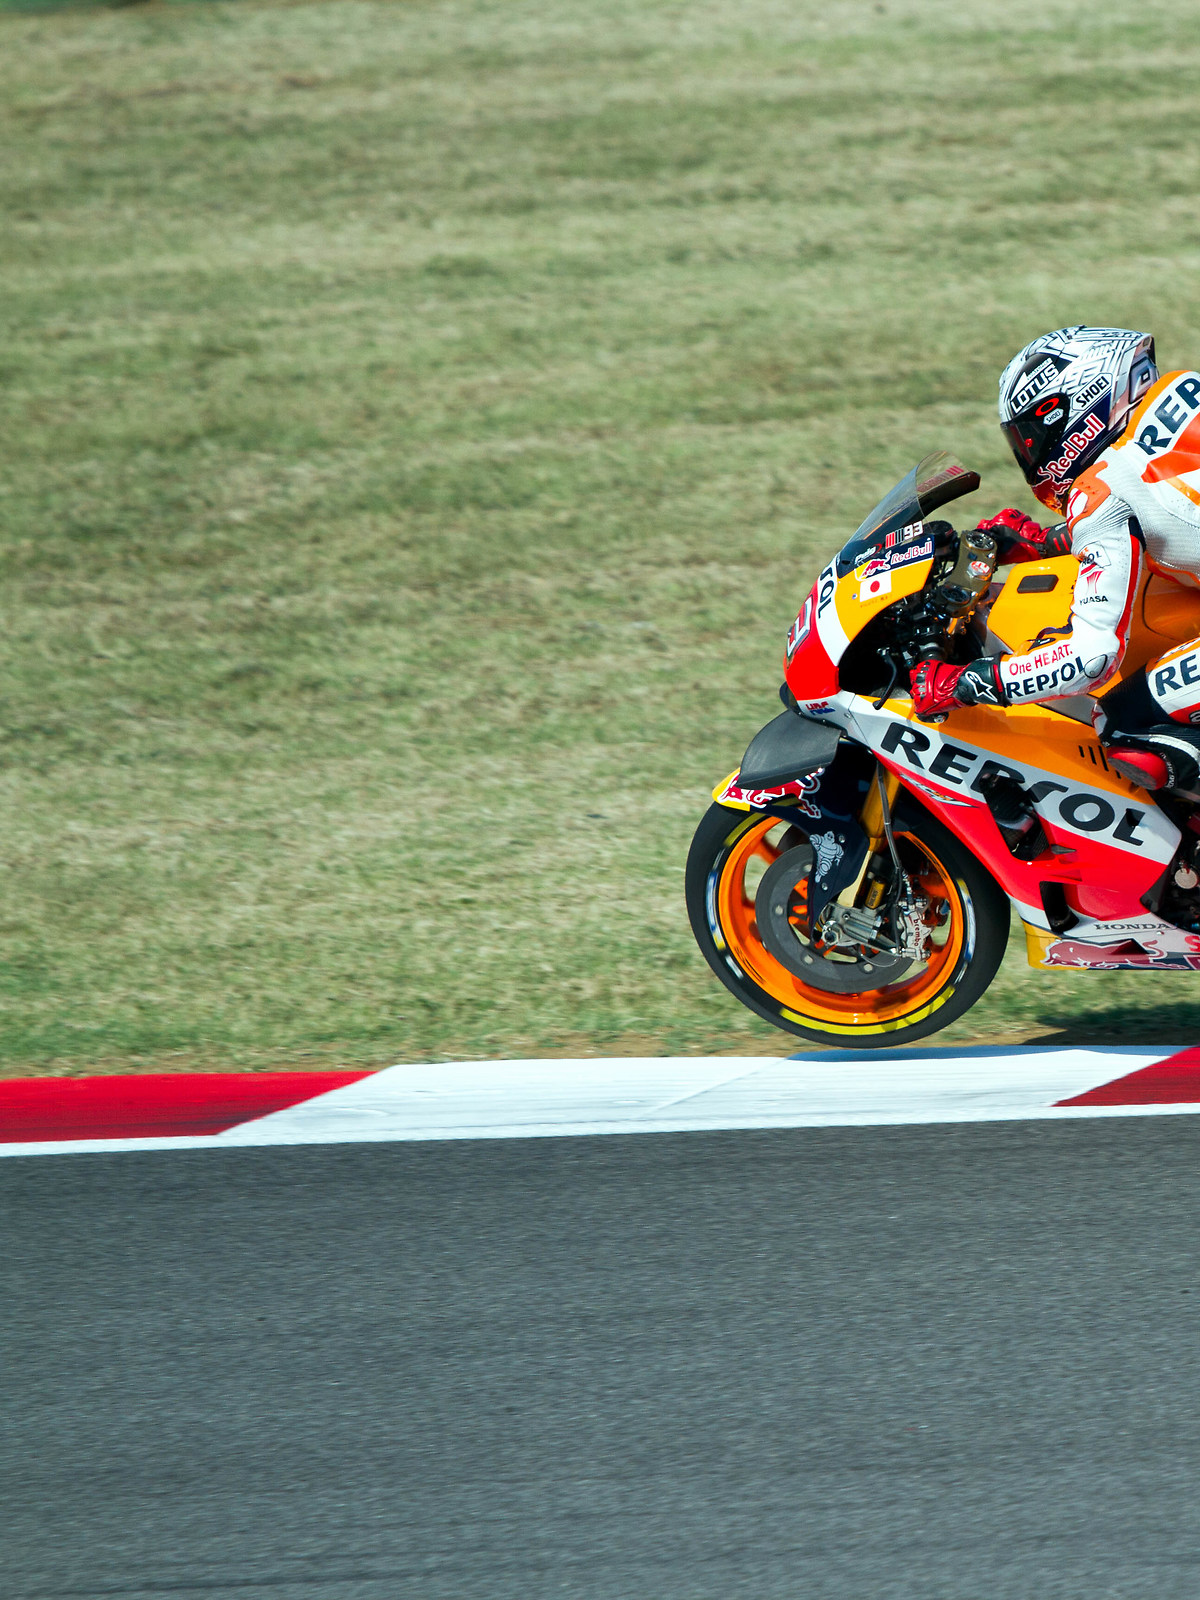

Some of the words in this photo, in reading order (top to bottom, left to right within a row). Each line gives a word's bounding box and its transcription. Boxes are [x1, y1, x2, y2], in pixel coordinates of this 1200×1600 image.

[1010, 364, 1060, 413] LOTUS
[1075, 375, 1110, 407] SHOEI
[1047, 441, 1080, 478] Red
[1069, 413, 1106, 450] Bull
[903, 521, 923, 540] 93
[891, 547, 912, 565] Red
[912, 541, 932, 558] Bull
[1009, 663, 1032, 676] One
[1034, 644, 1073, 669] HEART.
[1006, 656, 1085, 698] REPSOL
[1093, 922, 1170, 931] HONDA
